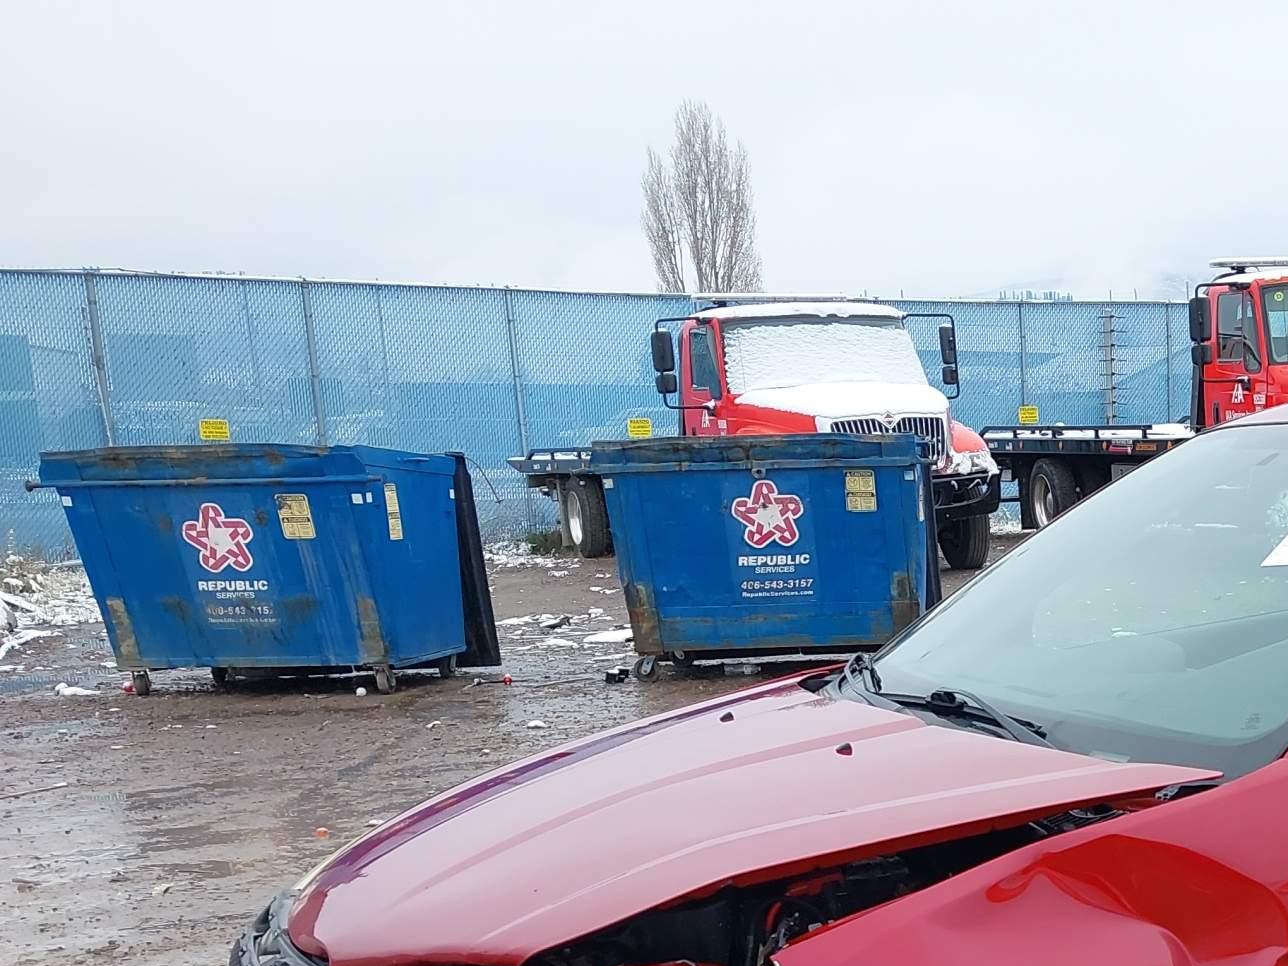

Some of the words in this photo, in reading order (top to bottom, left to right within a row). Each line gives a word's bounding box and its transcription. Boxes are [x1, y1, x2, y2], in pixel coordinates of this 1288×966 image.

[738, 554, 810, 566] REPUBLIC
[755, 566, 795, 574] SERVICES
[198, 580, 269, 591] REPUBLIC
[741, 579, 813, 590] 406-543-3157
